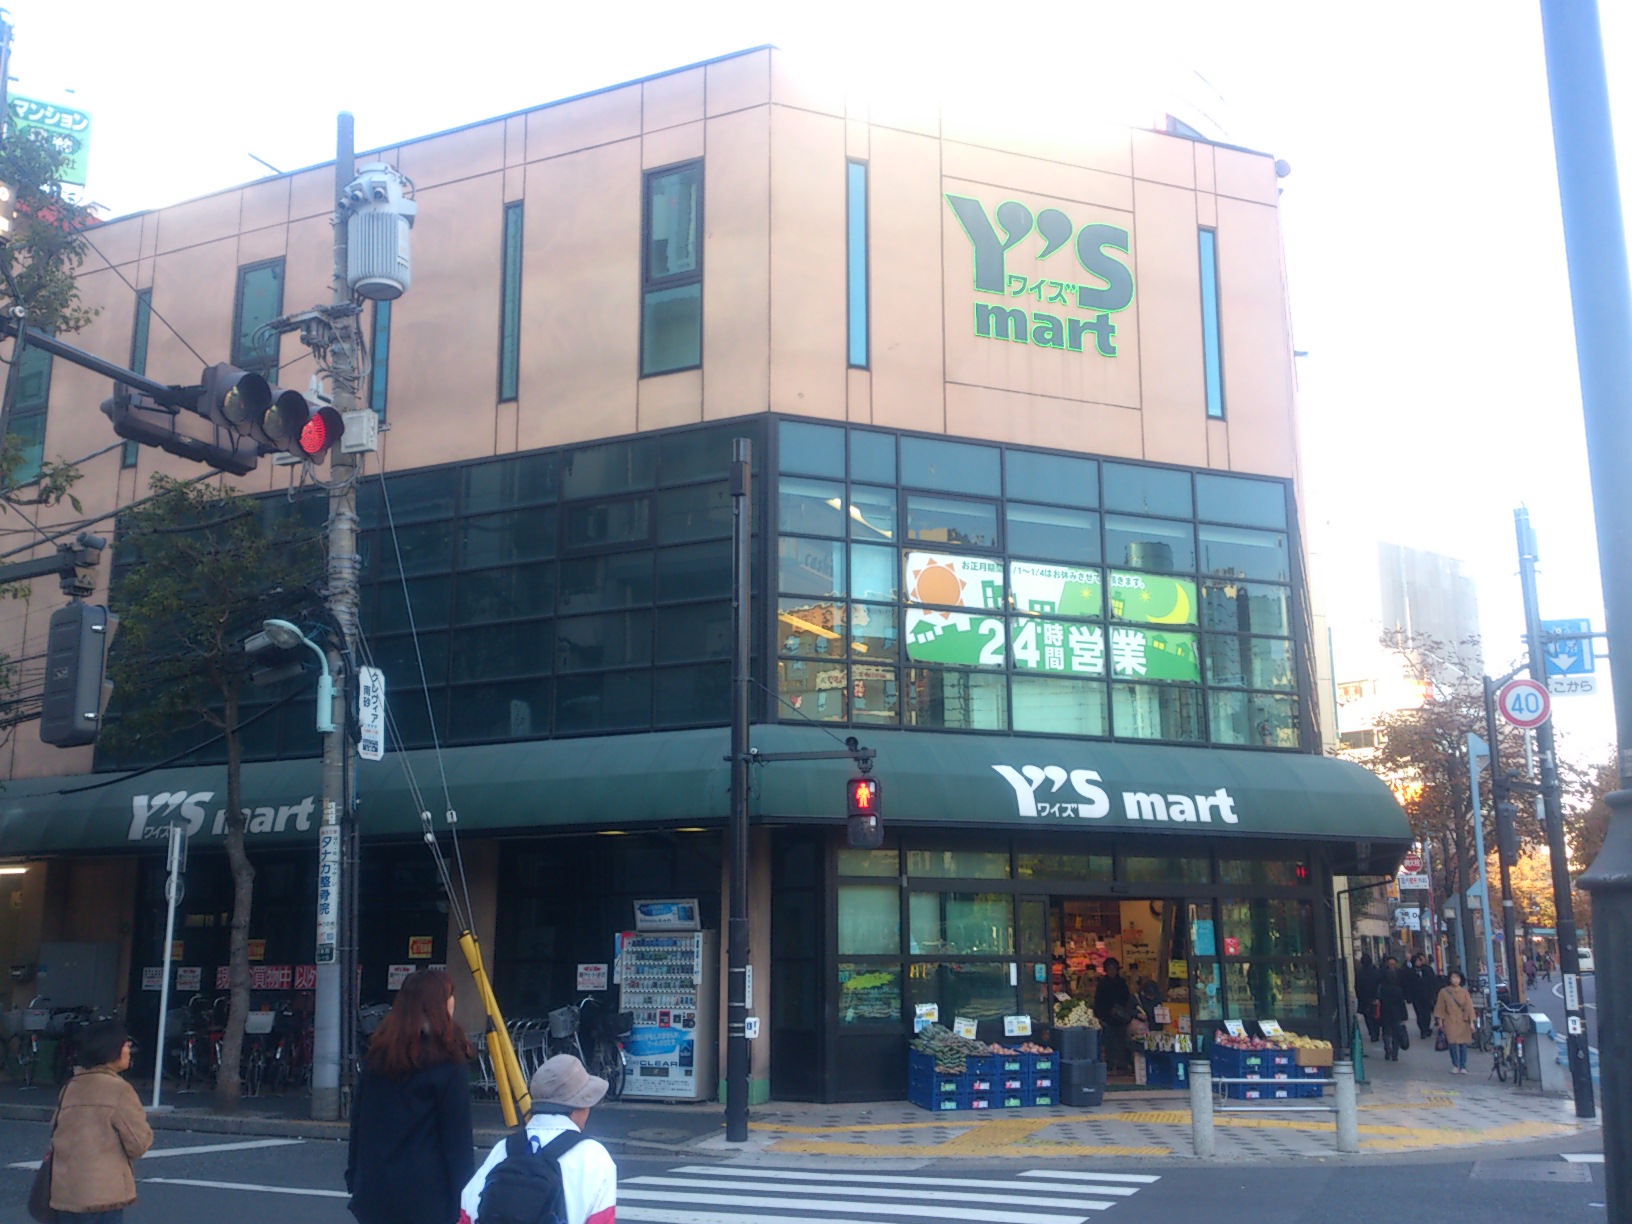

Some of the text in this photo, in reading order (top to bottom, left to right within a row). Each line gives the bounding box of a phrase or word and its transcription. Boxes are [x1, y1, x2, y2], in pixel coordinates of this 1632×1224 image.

[13, 99, 89, 131] マンション
[1007, 274, 1077, 304] ワイズ
[974, 301, 1118, 357] mart
[1511, 692, 1540, 714] 40
[211, 796, 315, 836] mart
[1037, 802, 1078, 818] ワイズ
[1122, 787, 1239, 824] mart
[319, 836, 332, 915] タナカ整骨院
[216, 966, 292, 988] 現買物中
